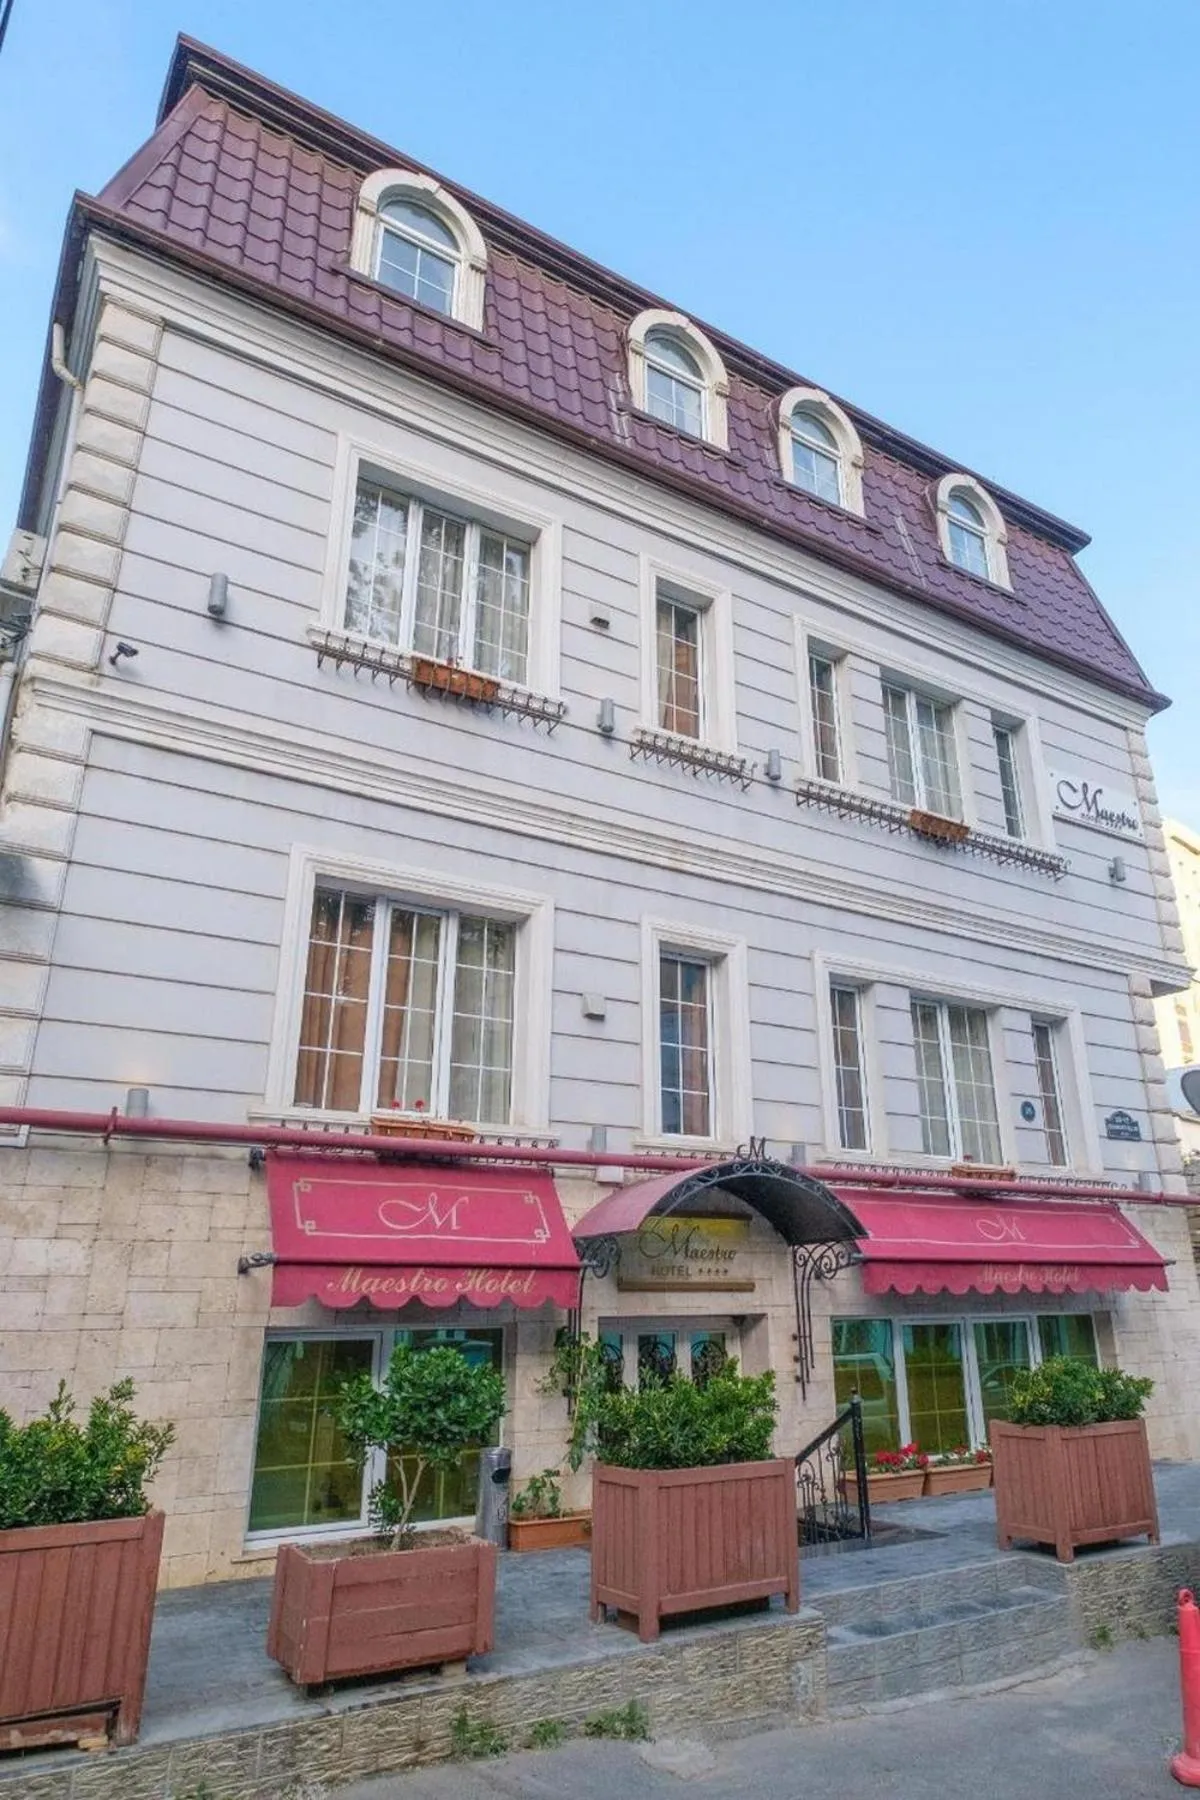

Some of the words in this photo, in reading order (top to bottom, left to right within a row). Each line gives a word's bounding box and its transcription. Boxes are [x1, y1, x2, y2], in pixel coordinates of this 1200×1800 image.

[638, 1223, 738, 1261] Maestro
[326, 1266, 449, 1294] Maestro
[455, 1267, 538, 1294] Hotel
[651, 1265, 693, 1277] HOTEL
